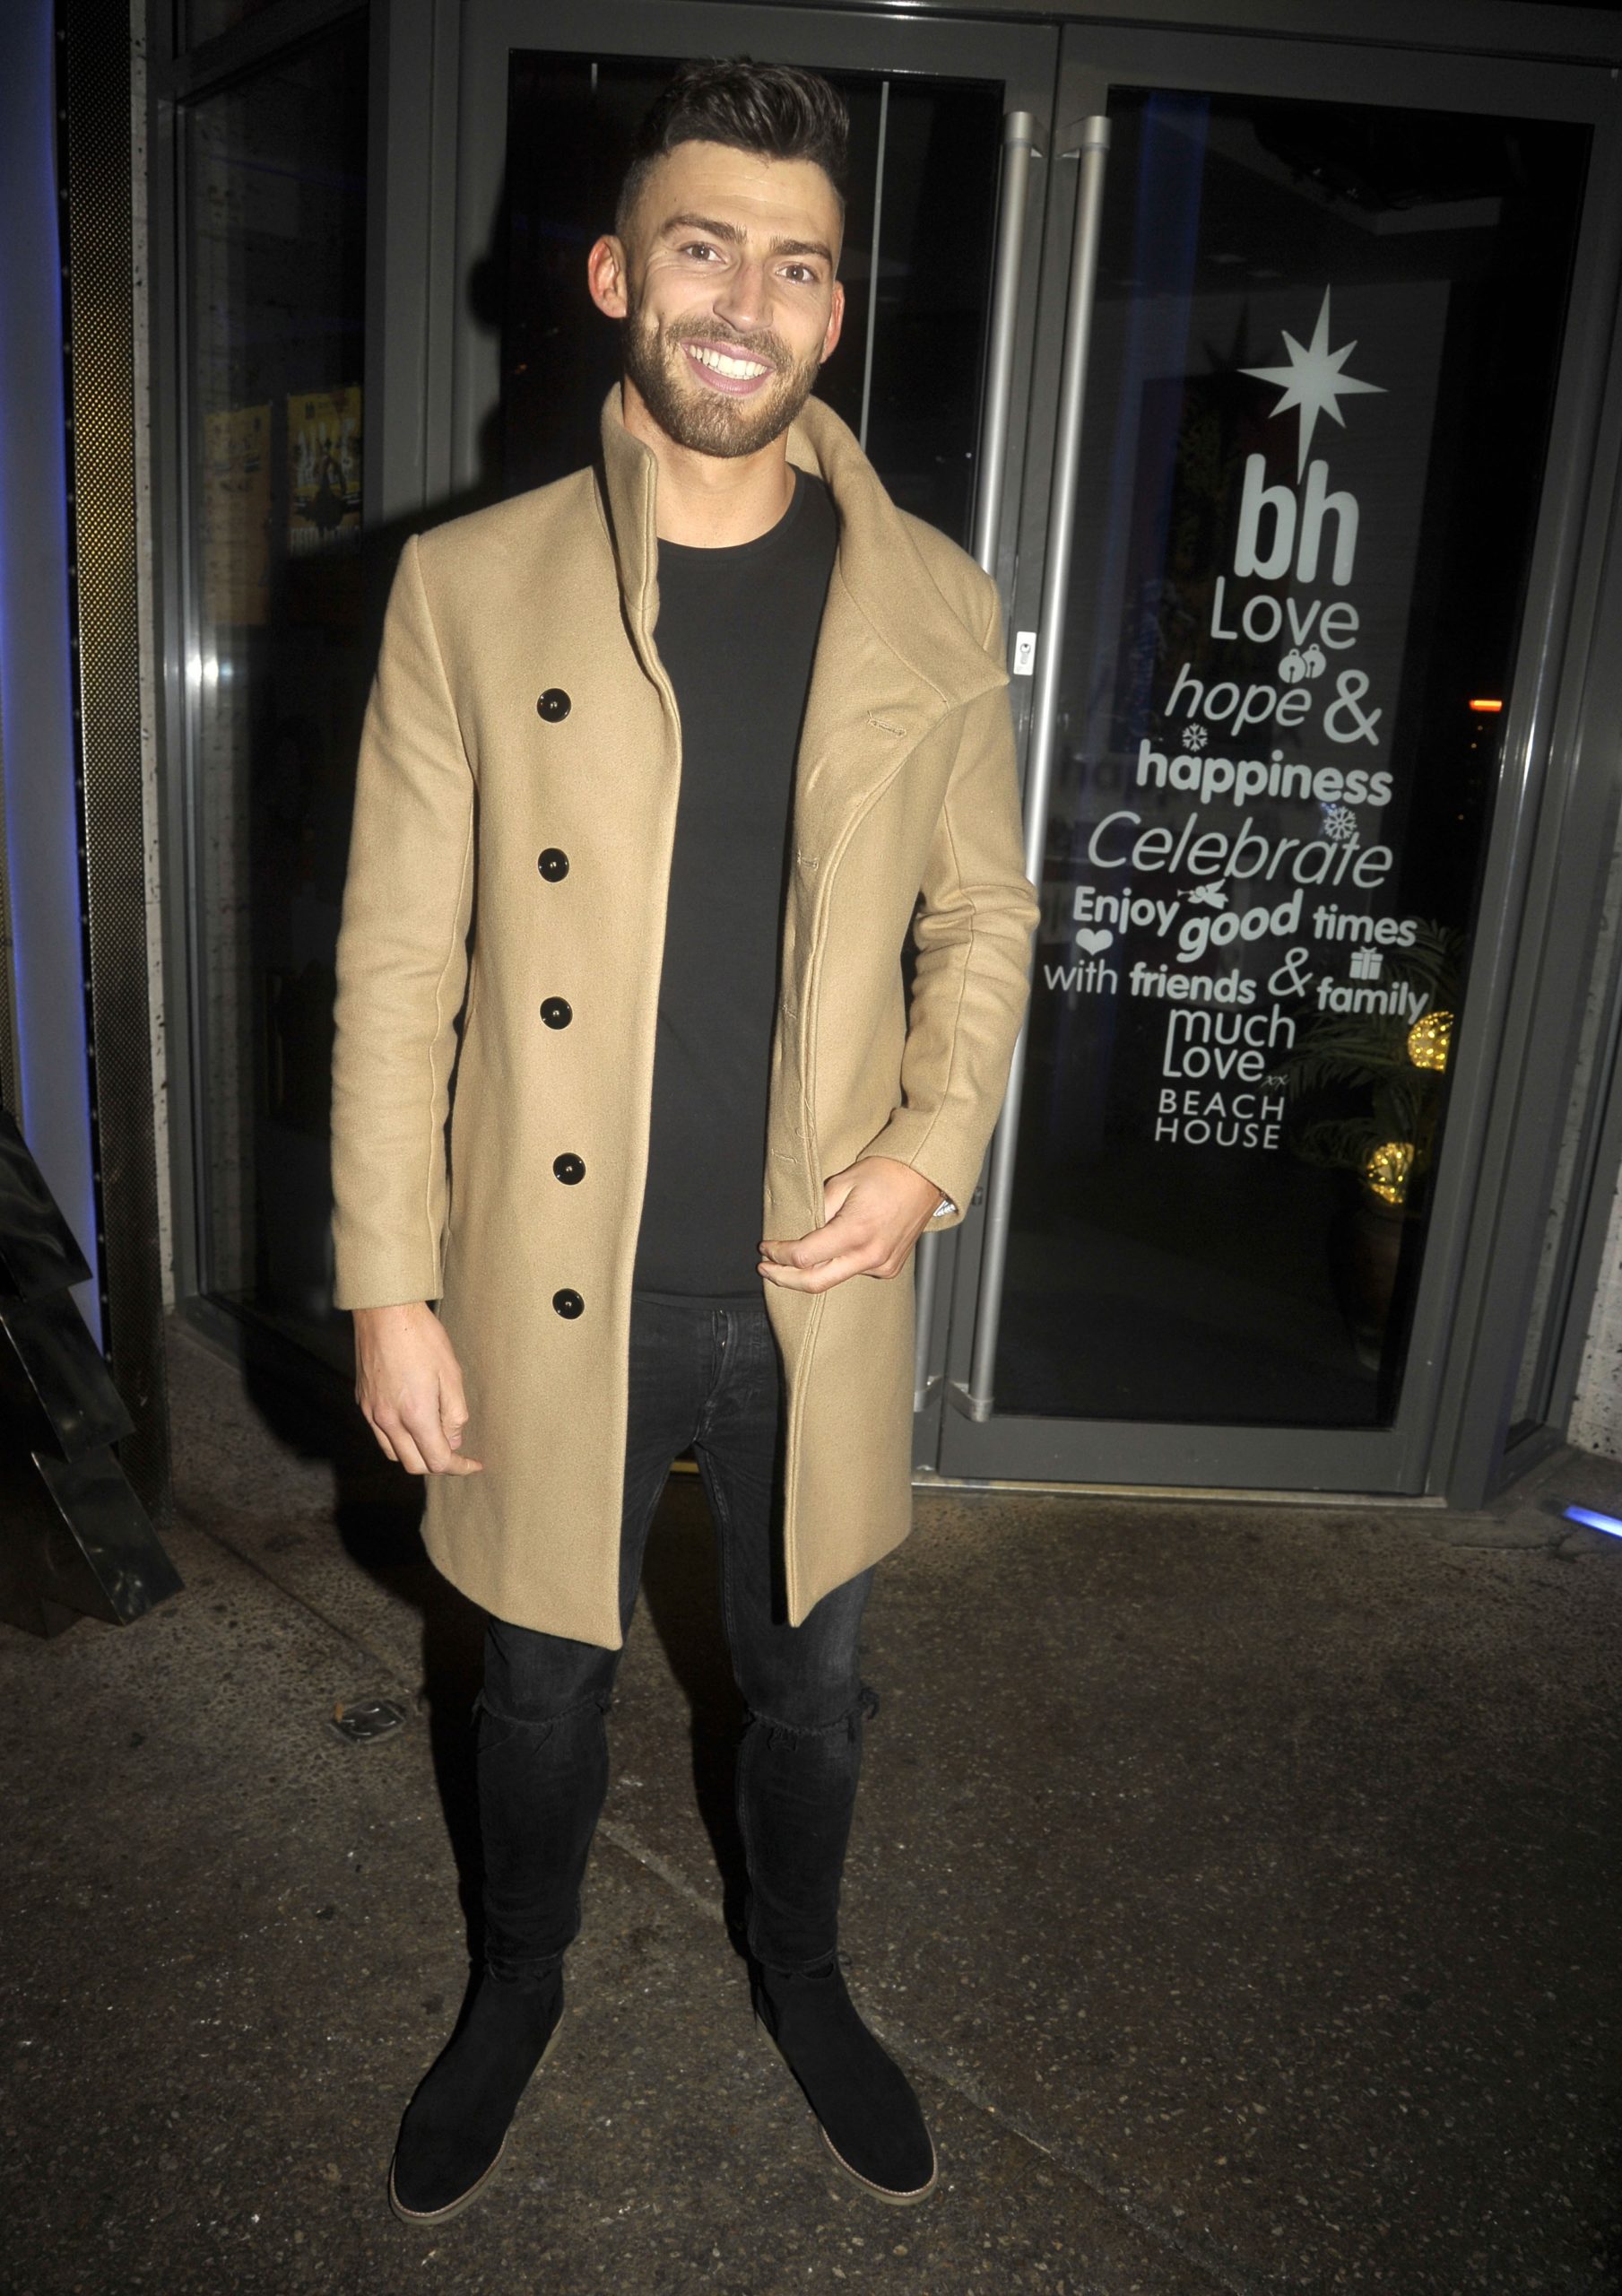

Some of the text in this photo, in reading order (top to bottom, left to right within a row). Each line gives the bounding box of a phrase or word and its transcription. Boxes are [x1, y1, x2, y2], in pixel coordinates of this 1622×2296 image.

[1234, 453, 1359, 587] bh
[1210, 576, 1360, 650] Love
[1165, 662, 1383, 746] hope &
[1136, 738, 1393, 806] happiness
[1088, 810, 1393, 888] Celebrate
[1072, 886, 1418, 963] Enjoy good times
[1044, 946, 1429, 1025] with friends & family
[1162, 1037, 1266, 1082] Love
[1168, 1003, 1297, 1050] much
[1154, 1117, 1282, 1150] HOUSE
[1158, 1088, 1285, 1121] BEACH
